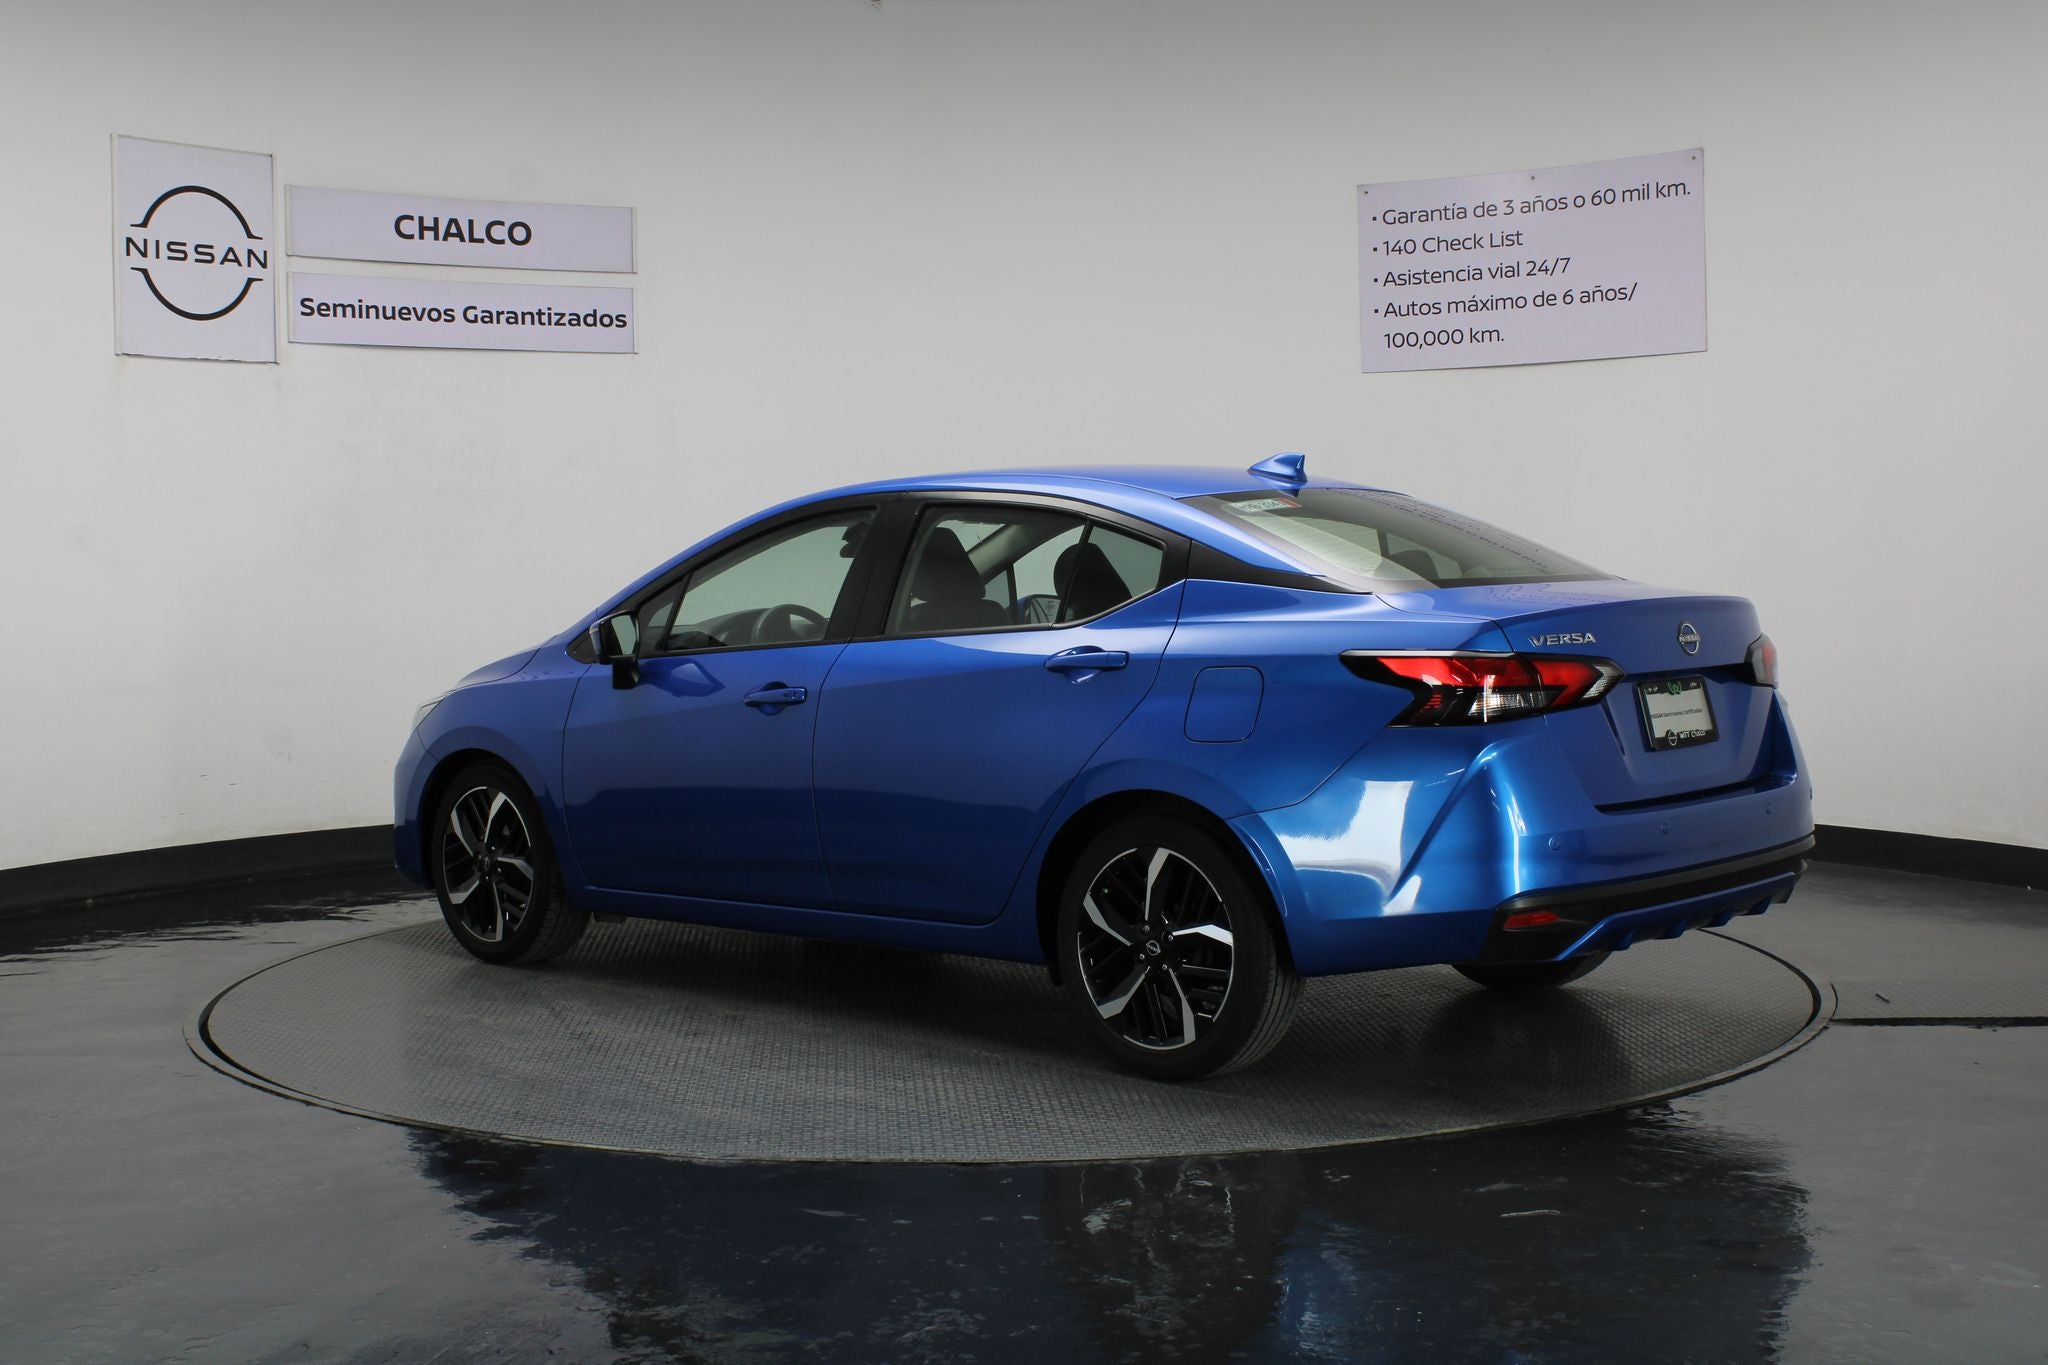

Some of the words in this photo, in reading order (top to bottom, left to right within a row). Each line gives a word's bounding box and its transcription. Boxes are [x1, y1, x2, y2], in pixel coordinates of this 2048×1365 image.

[1382, 203, 1468, 226] Garantía
[1472, 202, 1498, 218] de
[1503, 199, 1515, 215] 3
[1520, 195, 1568, 214] años
[1573, 194, 1586, 209] o
[1591, 188, 1617, 206] 60
[1621, 183, 1650, 203] mil
[1655, 180, 1691, 199] km.
[393, 214, 532, 247] CHALCO
[1382, 239, 1417, 256] 140
[1422, 233, 1485, 254] Check
[1489, 230, 1524, 249] List
[125, 236, 268, 270] NISSAN
[1382, 265, 1483, 287] Asistencia
[1487, 260, 1520, 280] vial
[1525, 257, 1571, 278] 24/7
[299, 297, 456, 323] Seminuevos
[462, 305, 628, 329] Garantizados
[1383, 300, 1442, 318] Autos
[1447, 294, 1528, 314] máximo
[1532, 291, 1557, 308] de
[1562, 288, 1575, 305] 6
[1579, 282, 1638, 304] años/
[1383, 329, 1464, 350] 100,000
[1469, 328, 1505, 344] km.
[1528, 633, 1597, 647] VERSA
